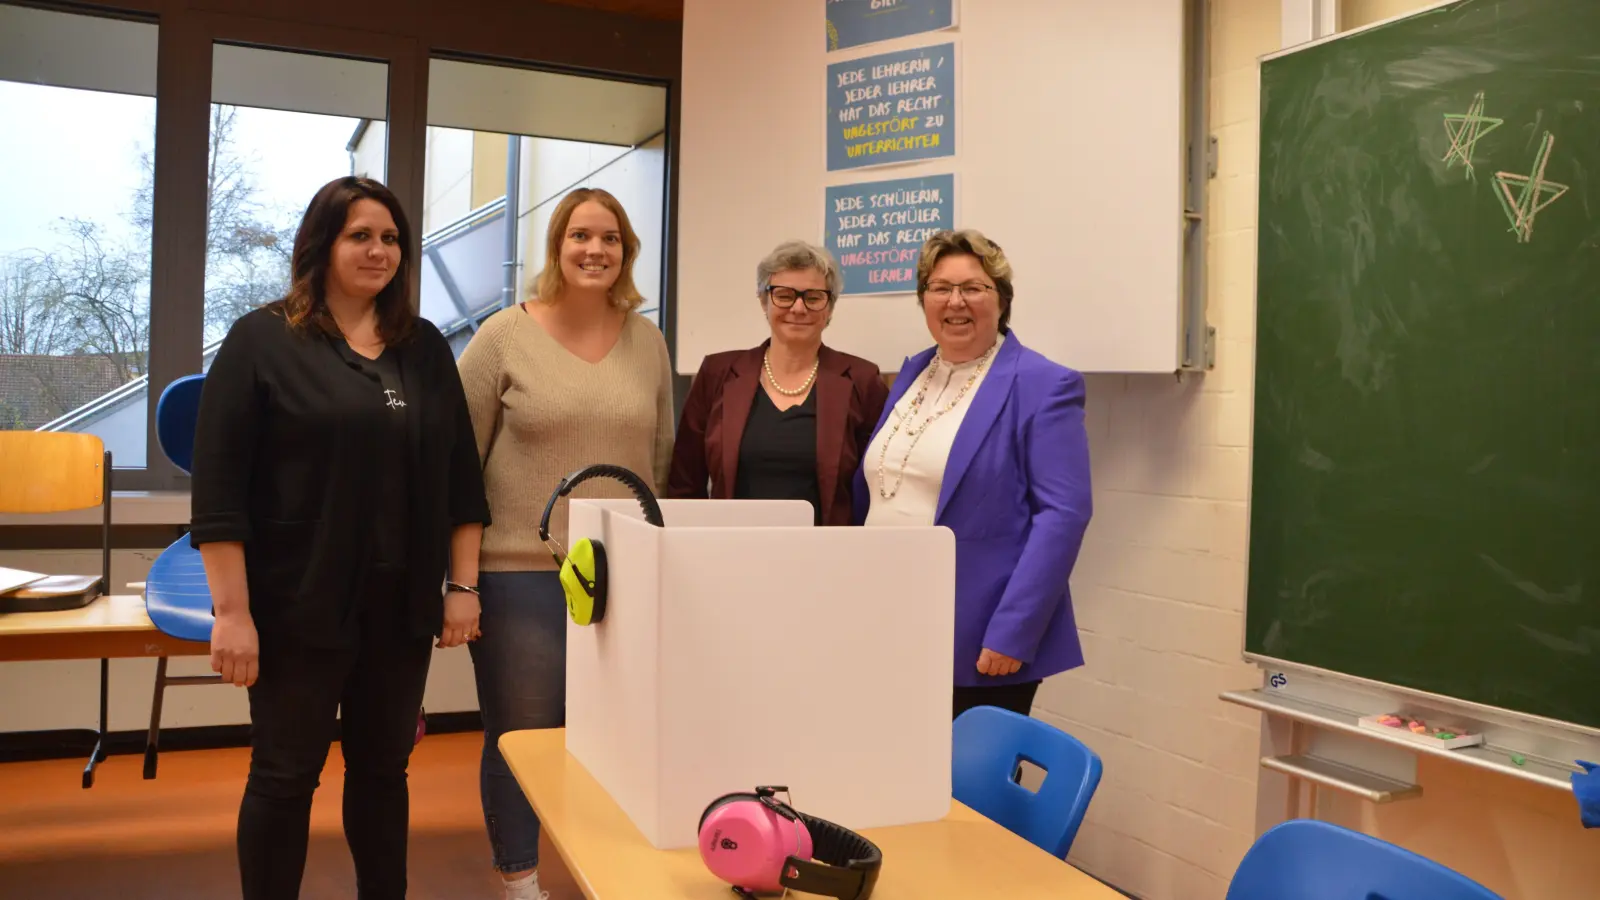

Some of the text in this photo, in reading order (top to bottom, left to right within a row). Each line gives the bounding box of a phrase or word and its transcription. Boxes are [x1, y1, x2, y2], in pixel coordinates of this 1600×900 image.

[837, 68, 866, 88] JEDE
[872, 58, 931, 80] LEHRERIN
[845, 76, 936, 105] JEDER LEHRER
[839, 95, 943, 122] HAT DAS RECHT
[843, 114, 944, 140] UNGESTÖRT ZU
[847, 133, 940, 158] UNTERRICHTEN
[834, 188, 943, 213] JEDE SCHÜLERIN,
[838, 206, 940, 231] JEDER SCHÜLER
[837, 233, 862, 248] HAT
[868, 231, 891, 246] DAS
[841, 245, 918, 267] UNGESTÖRT
[868, 267, 913, 284] LERNEN
[1270, 672, 1287, 688] GS
